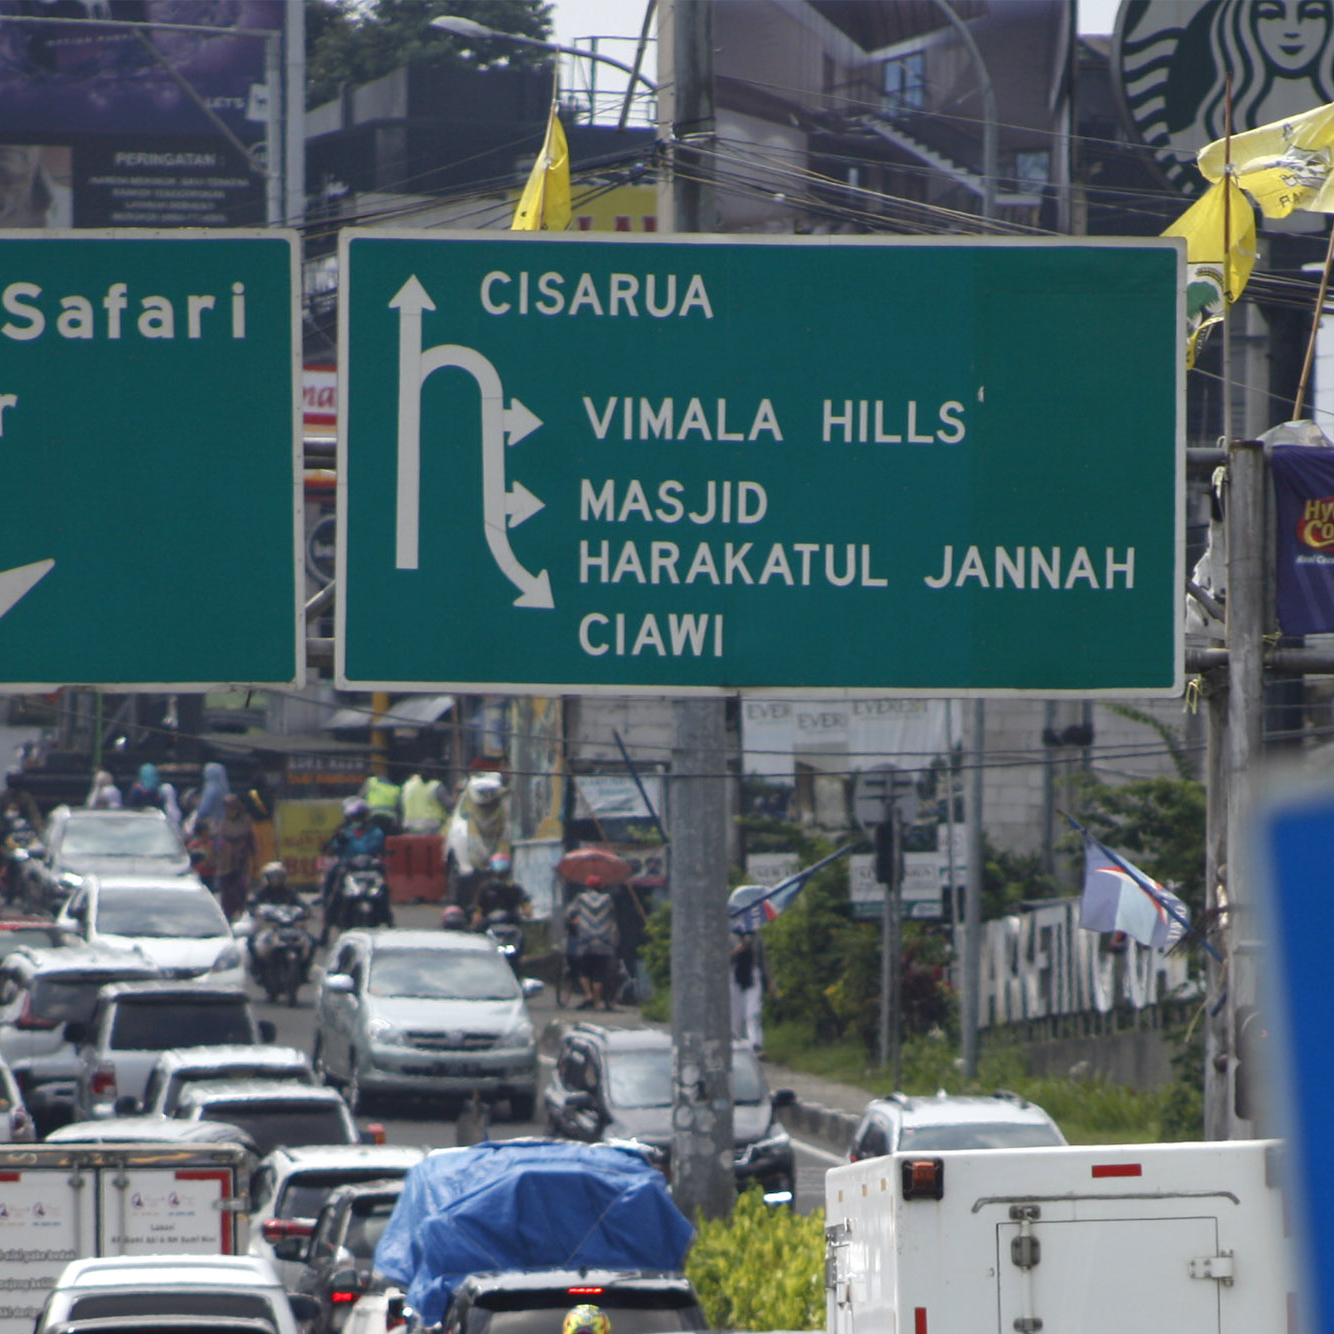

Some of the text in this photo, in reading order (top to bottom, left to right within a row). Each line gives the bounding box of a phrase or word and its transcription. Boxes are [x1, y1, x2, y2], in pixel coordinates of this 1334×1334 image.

[115, 153, 216, 167] PERINGATAN
[1, 281, 247, 341] Safari
[480, 271, 714, 319] CISARUA
[583, 396, 966, 445] VIMALA HILLS
[580, 479, 768, 526] MASJID
[580, 541, 1136, 590] HARAKATUL JANNAH
[578, 613, 725, 658] CIAWI
